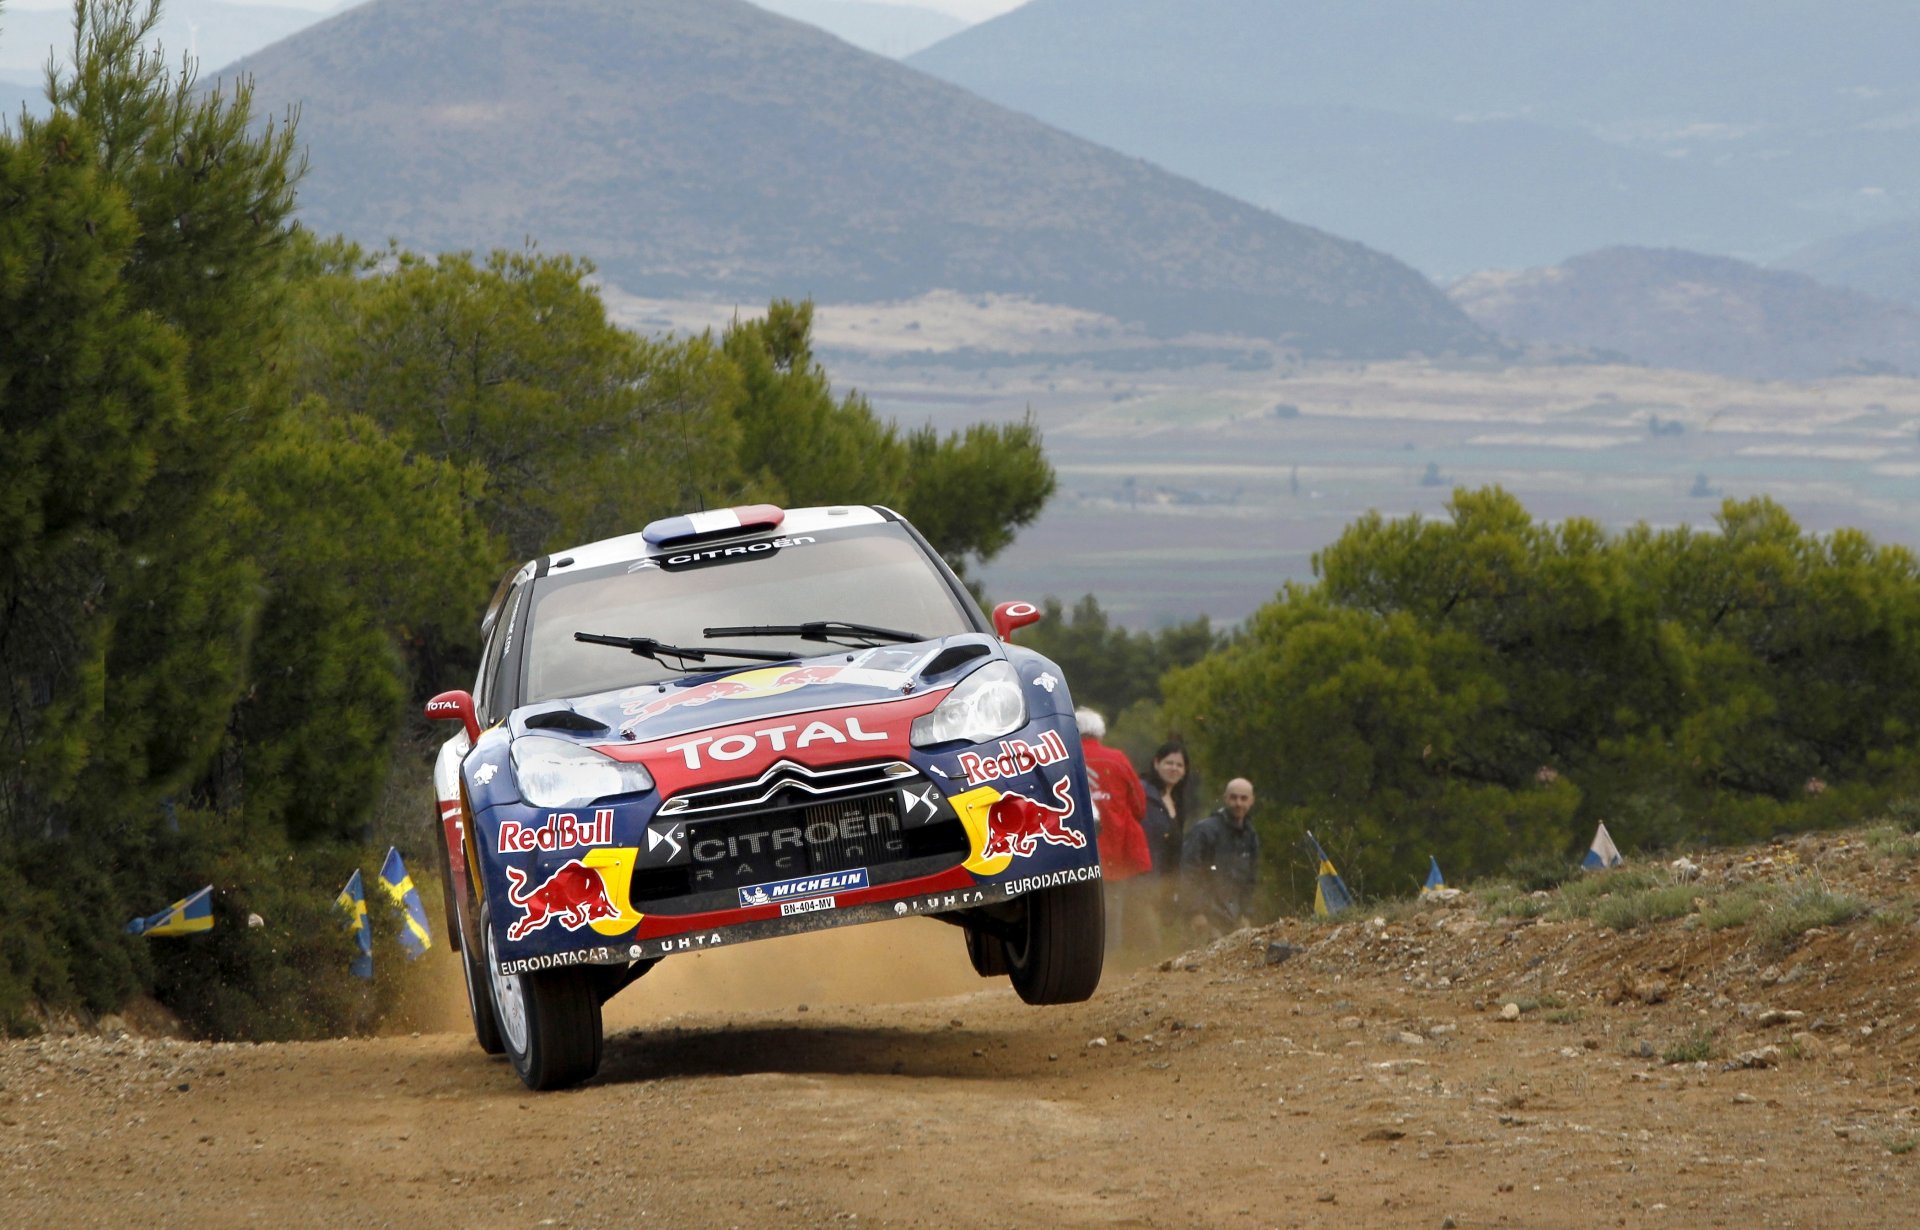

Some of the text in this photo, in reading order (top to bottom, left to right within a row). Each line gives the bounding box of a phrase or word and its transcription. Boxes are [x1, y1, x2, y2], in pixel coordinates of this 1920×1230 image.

[427, 701, 460, 712] TOTAL
[666, 717, 889, 770] TOTAL
[957, 729, 1070, 787] Red Bull
[498, 812, 558, 854] Red
[558, 808, 615, 851] Bull
[696, 839, 903, 881] RACING
[772, 873, 862, 897] MICHELIN
[1004, 865, 1101, 896] EURODATACAR
[783, 898, 832, 915] BN-404-MV
[501, 946, 609, 976] EURODATACAR
